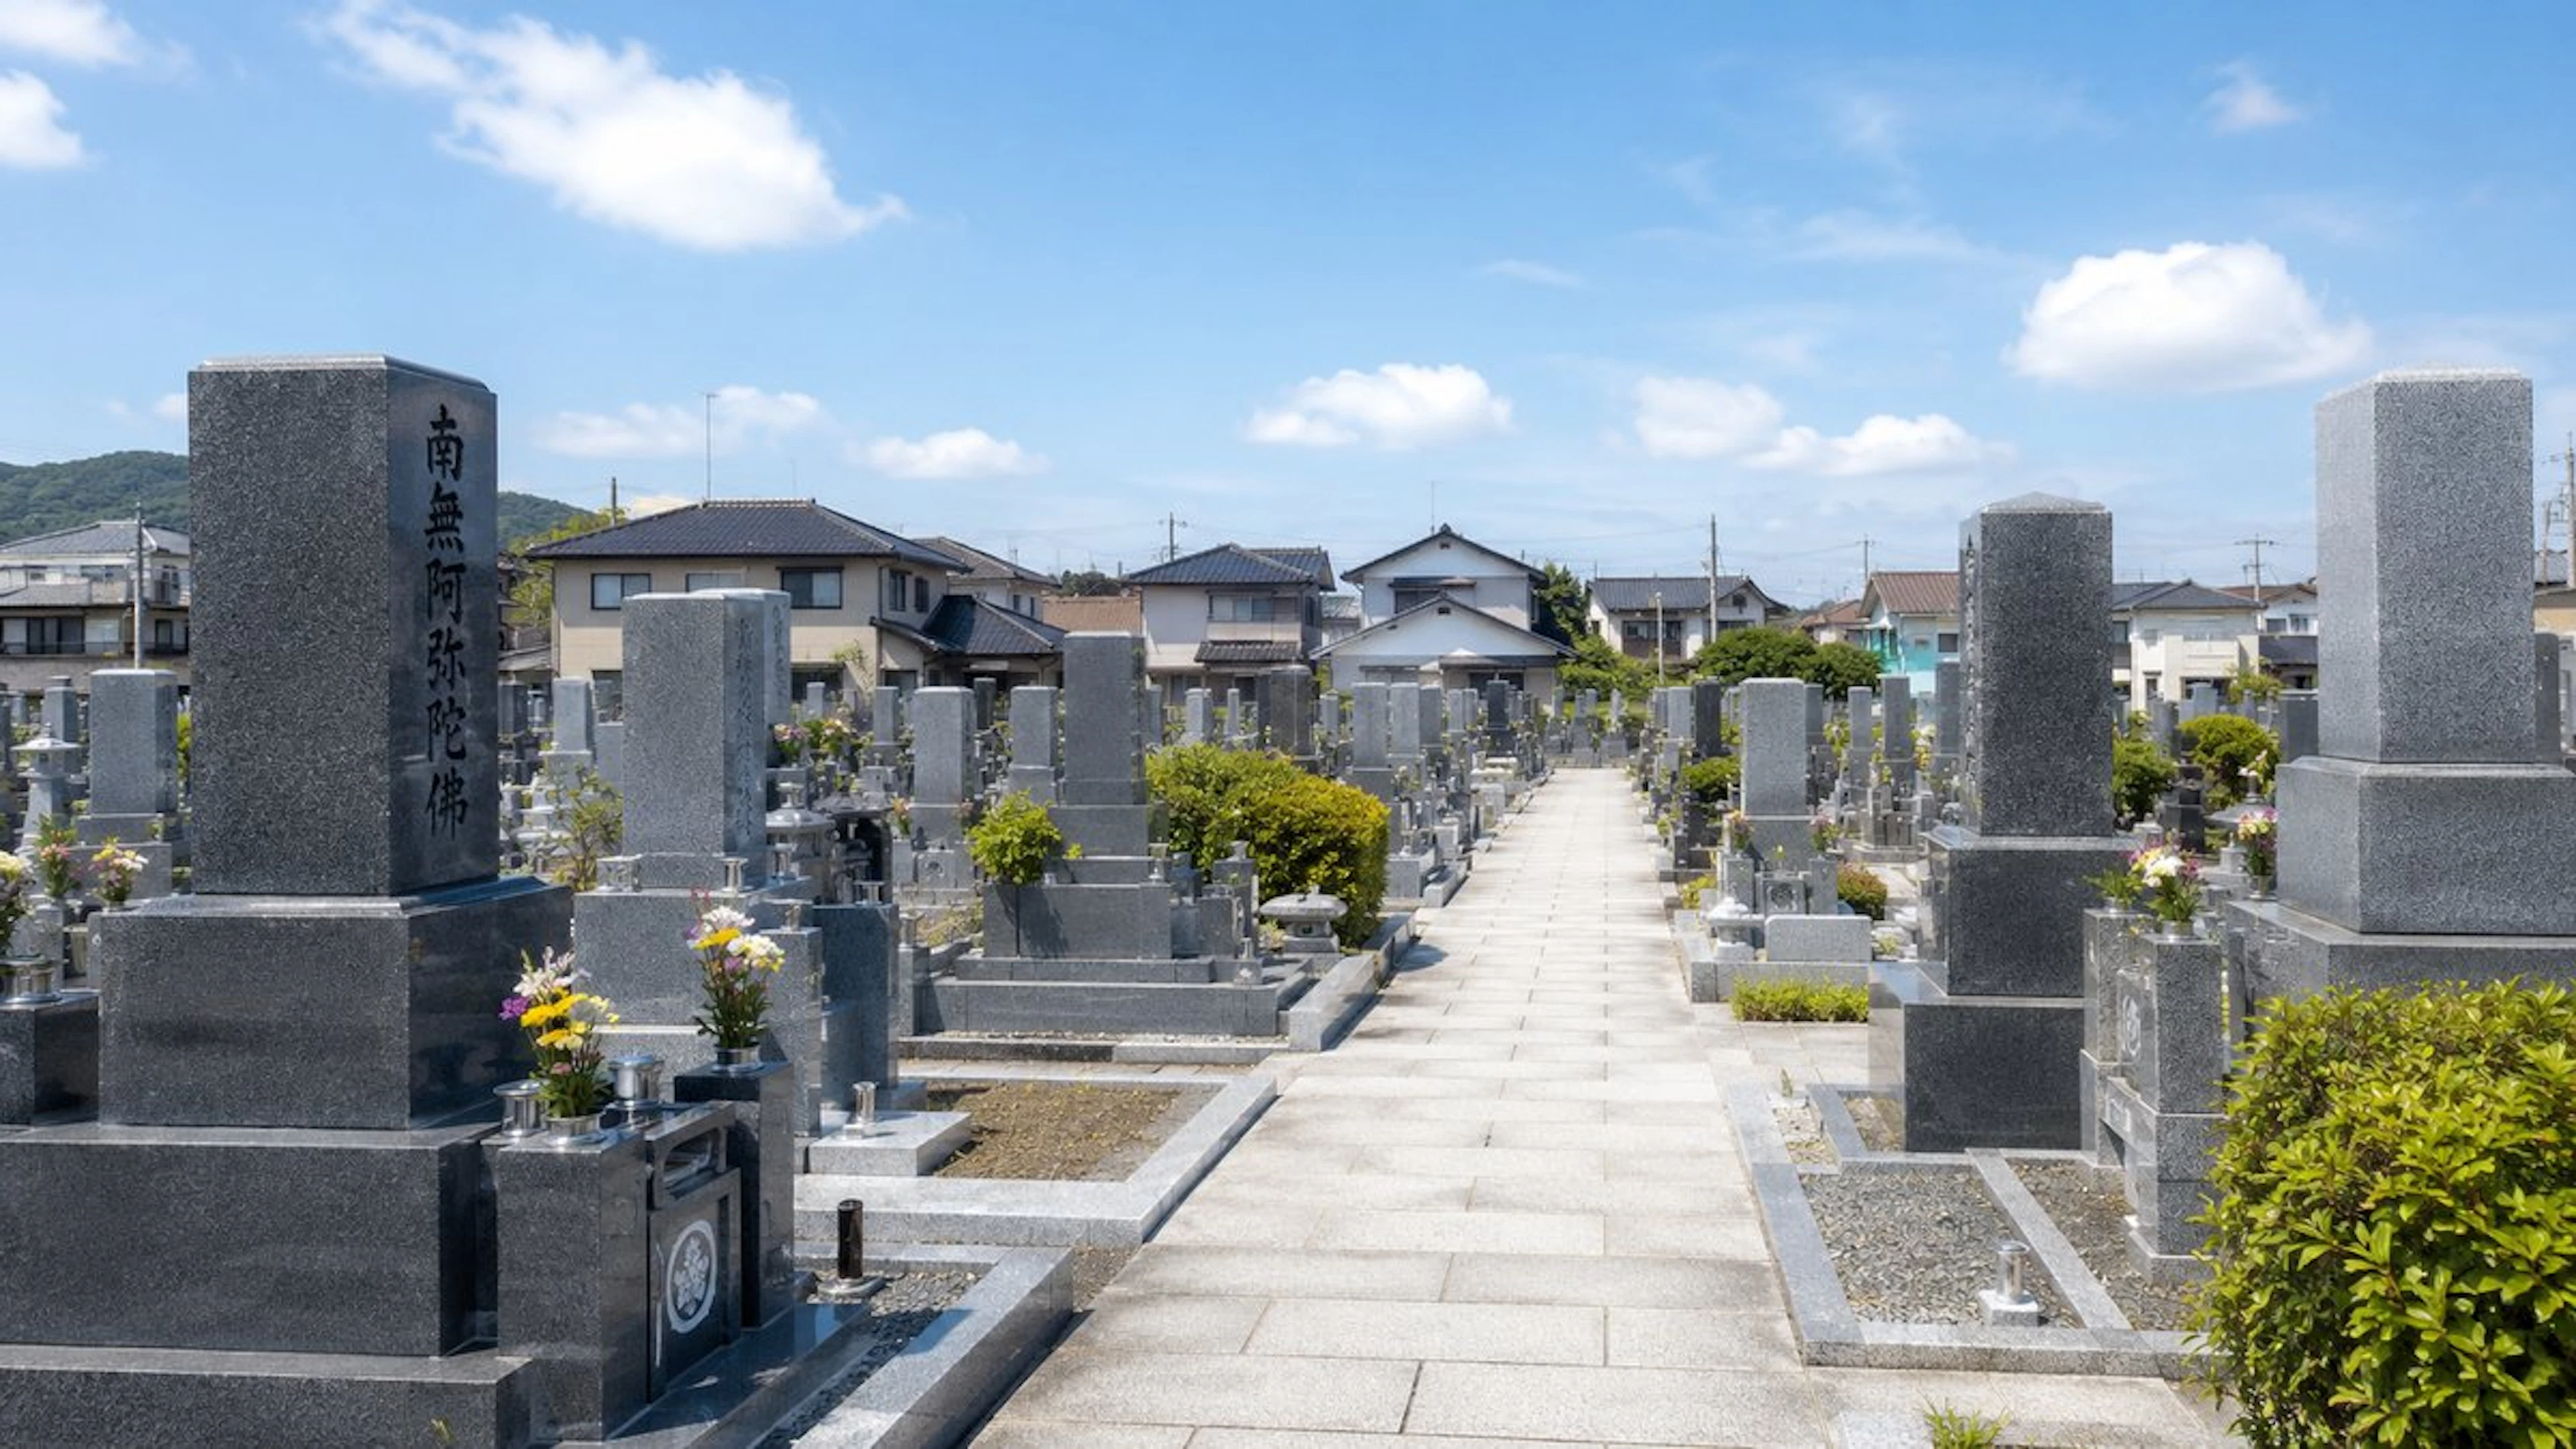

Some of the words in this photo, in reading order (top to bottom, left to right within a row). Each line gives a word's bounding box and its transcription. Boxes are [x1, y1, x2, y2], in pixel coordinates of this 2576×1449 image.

[425, 403, 468, 841] 南無阿弥陀佛
